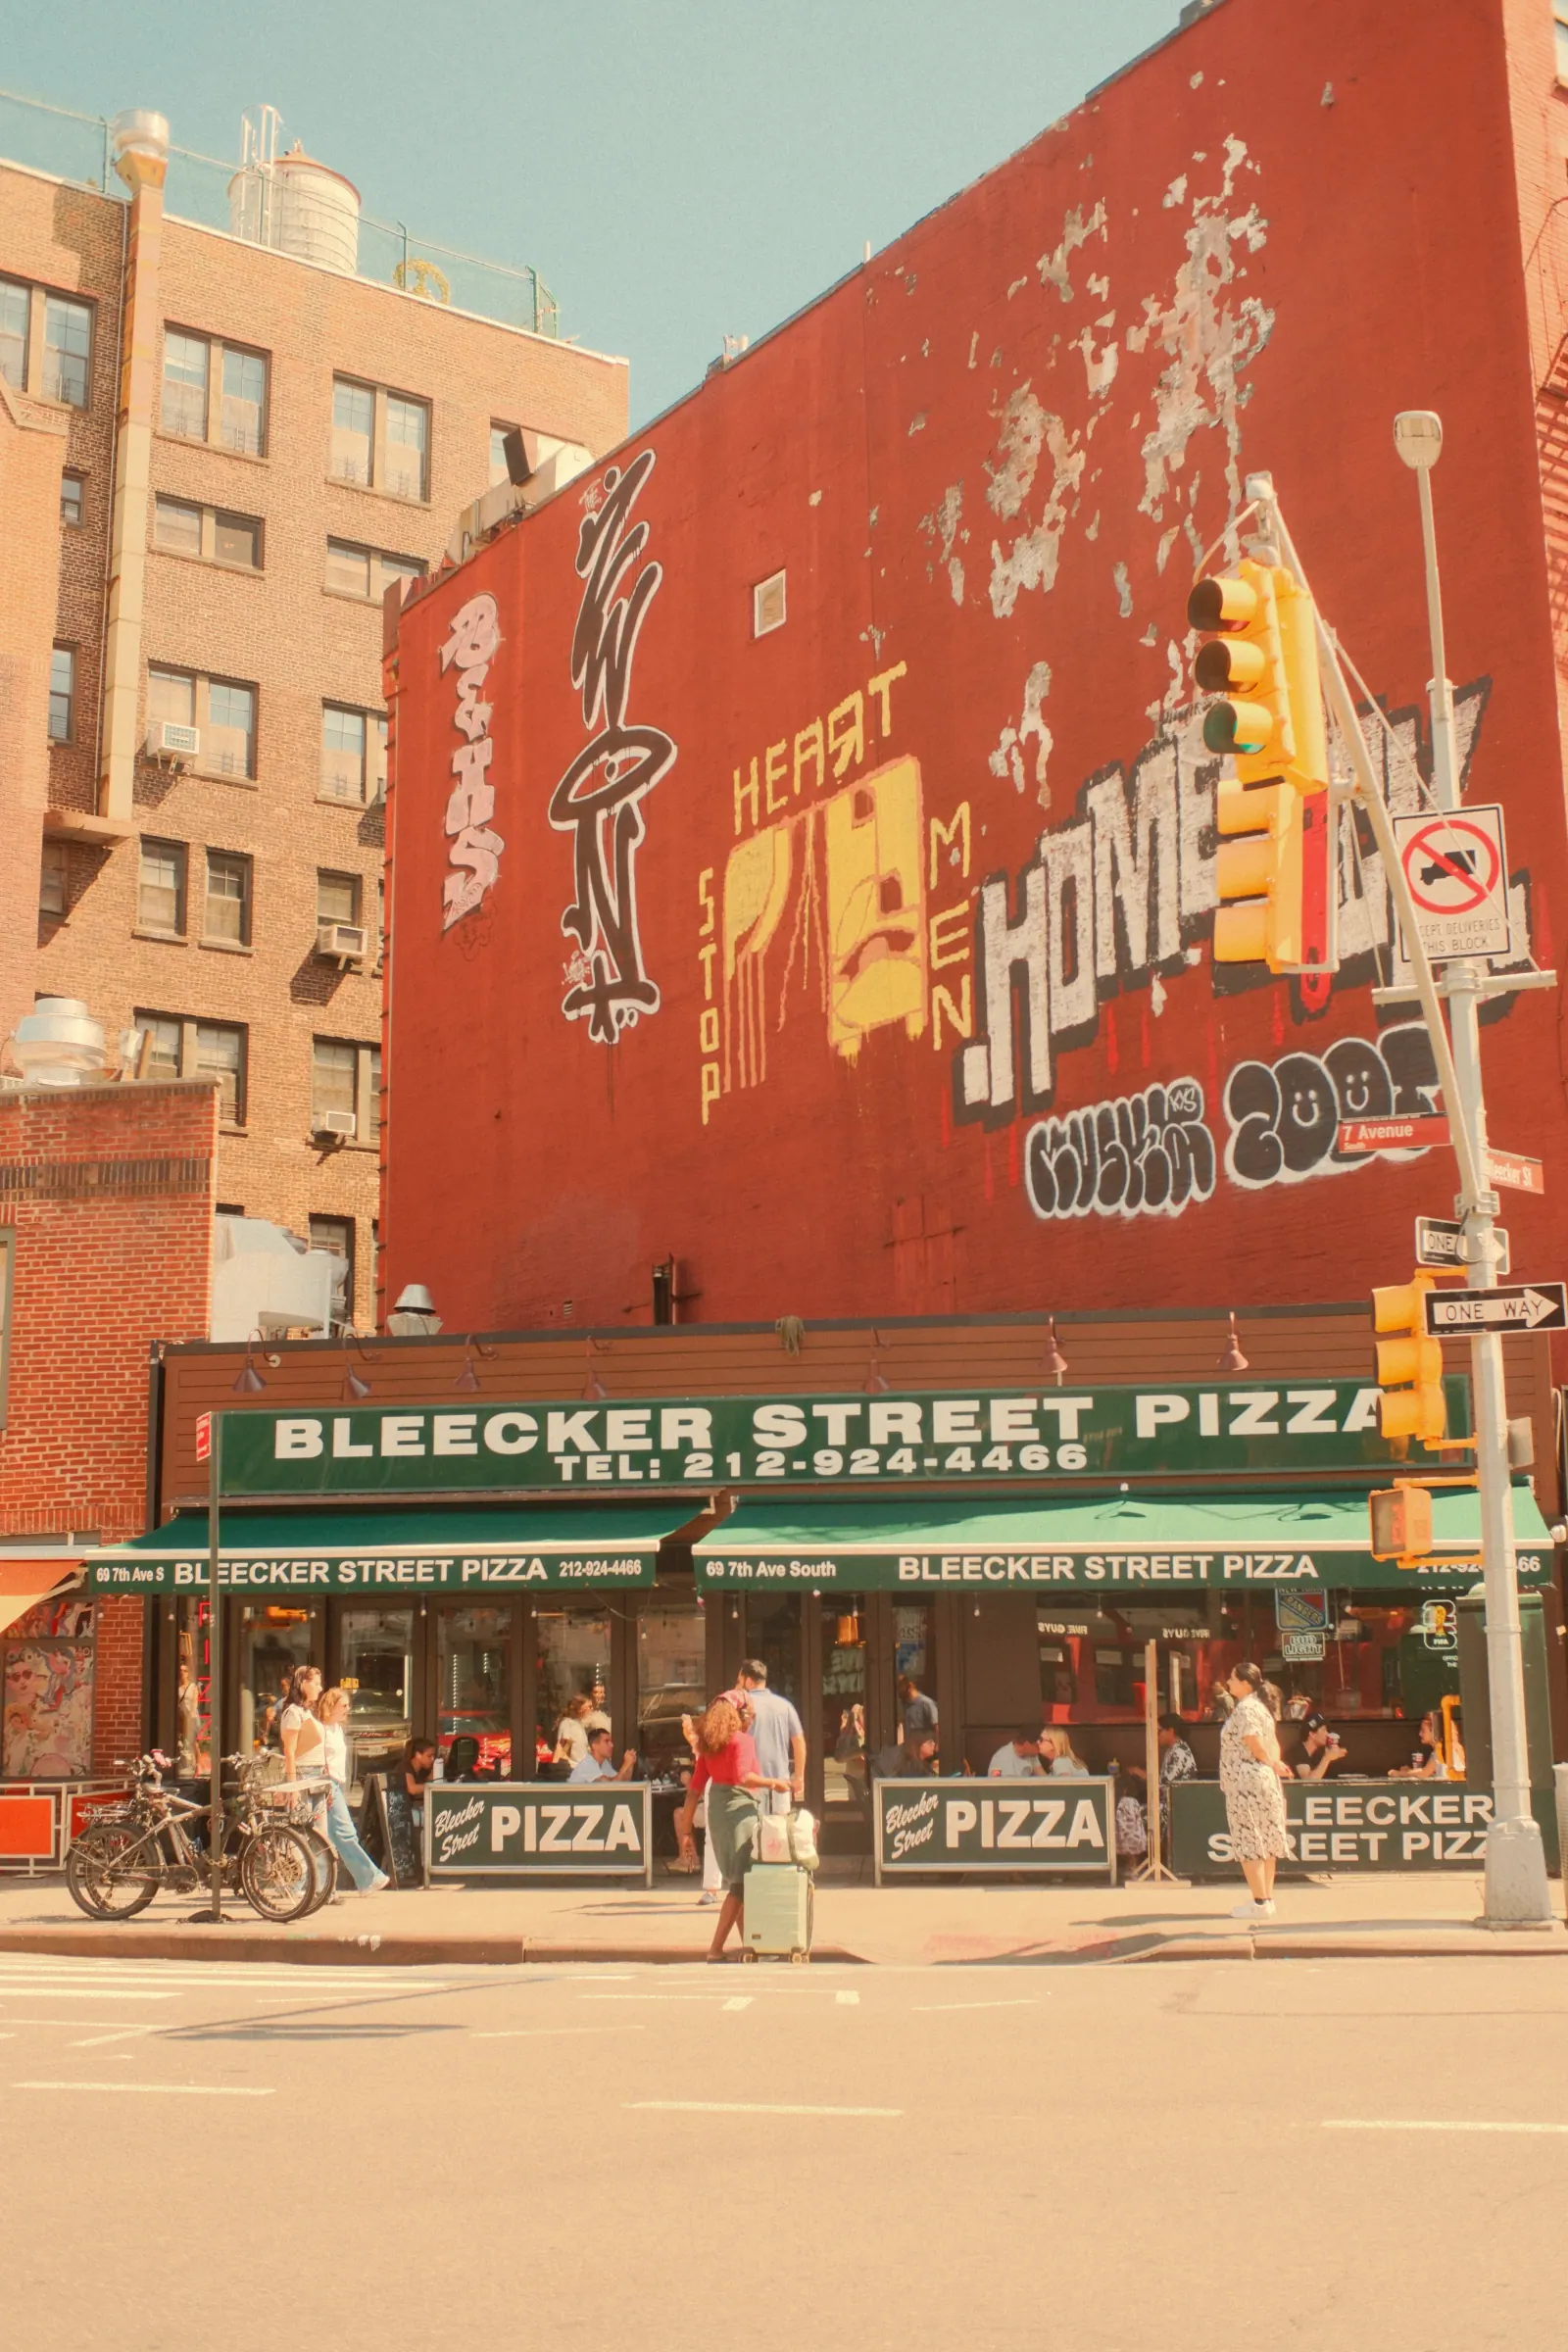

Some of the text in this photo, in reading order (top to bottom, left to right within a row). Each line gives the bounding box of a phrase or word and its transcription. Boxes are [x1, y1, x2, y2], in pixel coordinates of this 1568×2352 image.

[1419, 918, 1500, 937] CEPT DELIVERIES
[1452, 937, 1490, 951] BLOCK
[698, 866, 720, 1125] STOP
[1343, 1124, 1413, 1141] 7 Avenue
[1344, 1142, 1365, 1151] South
[1428, 1233, 1453, 1251] ONE
[1446, 1298, 1543, 1321] ONE WAY
[274, 1407, 712, 1458] BLEECKER
[753, 1397, 1093, 1447] STREET
[554, 1444, 1088, 1481] TEL: 212-924-4466
[96, 1558, 642, 1585] 69 7th Ave S BLEECKER STREET PIZZA 212-924-4466
[706, 1561, 724, 1577] 69
[728, 1561, 752, 1577] 7th
[756, 1561, 785, 1577] Ave
[790, 1560, 836, 1577] South
[898, 1556, 1075, 1581] BLEECKER
[1085, 1555, 1213, 1580] STREET
[1223, 1554, 1318, 1578] PIZZA
[1287, 1596, 1322, 1624] RANGERS
[1285, 1644, 1323, 1655] LIGHT
[1290, 1635, 1317, 1645] BUD
[434, 1796, 484, 1838] Bleecker
[885, 1791, 939, 1834] Bleecker
[946, 1799, 1104, 1847] PIZZA
[1284, 1795, 1495, 1826] LEECKER
[491, 1804, 641, 1851] PIZZA
[891, 1818, 934, 1859] Street
[439, 1823, 479, 1862] Street
